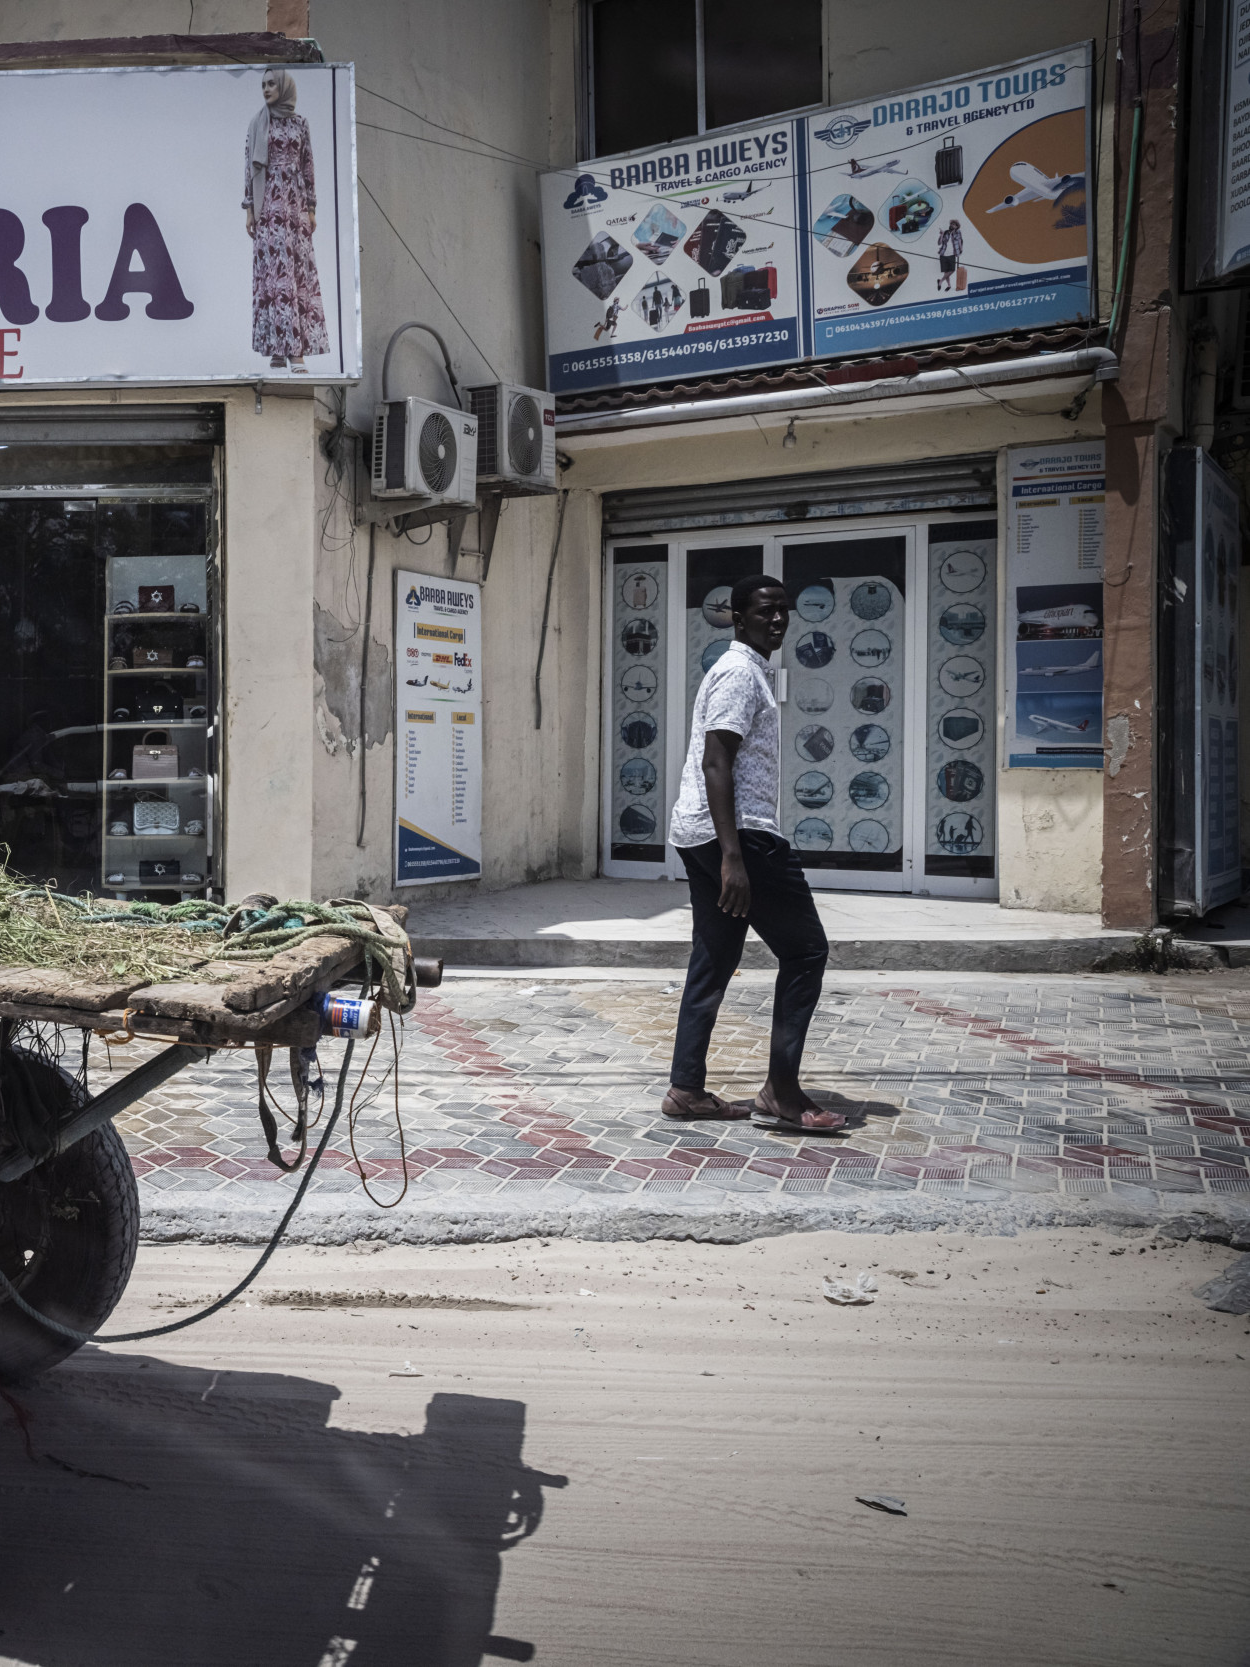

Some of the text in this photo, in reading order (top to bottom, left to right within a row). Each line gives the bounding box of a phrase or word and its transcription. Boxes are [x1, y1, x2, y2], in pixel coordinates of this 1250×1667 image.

[873, 63, 1066, 127] DARAJO TOURS
[906, 98, 1035, 136] & TRAVEL AGENCY LTD
[610, 131, 787, 190] BAABA AWEYS
[655, 157, 787, 193] TRAVEL & CARGO AGENCY
[606, 216, 628, 225] QATAR
[571, 330, 789, 372] 0615551358/615440796/613937230
[1040, 453, 1102, 465] DARAJO TOURS
[1021, 481, 1102, 495] International Cargo
[420, 585, 474, 609] BAABA AWEYS
[417, 626, 463, 642] International Cargo
[435, 655, 453, 663] DHL
[454, 652, 472, 667] FedEx
[408, 712, 434, 721] International
